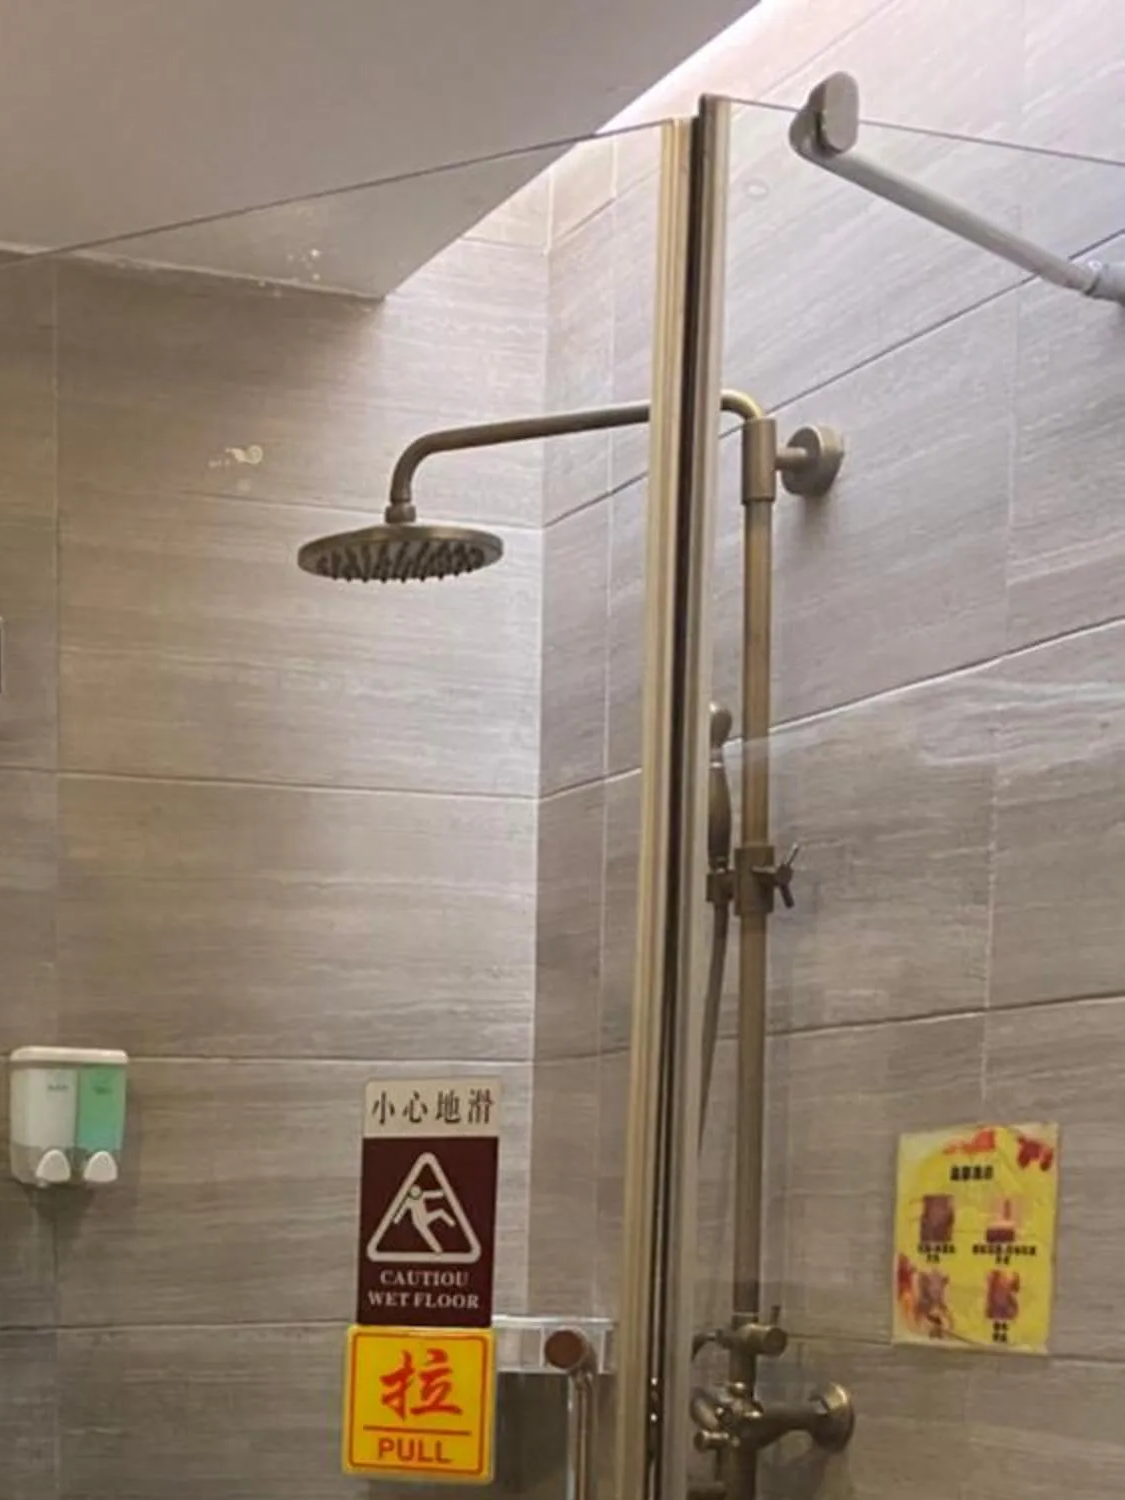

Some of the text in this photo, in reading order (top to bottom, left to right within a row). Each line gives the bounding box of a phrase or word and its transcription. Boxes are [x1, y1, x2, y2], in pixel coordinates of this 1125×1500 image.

[371, 1088, 496, 1125] 小心地滑
[367, 1289, 480, 1310] WET FLOOR
[380, 1348, 463, 1421] 拉
[377, 1436, 453, 1465] PULL
